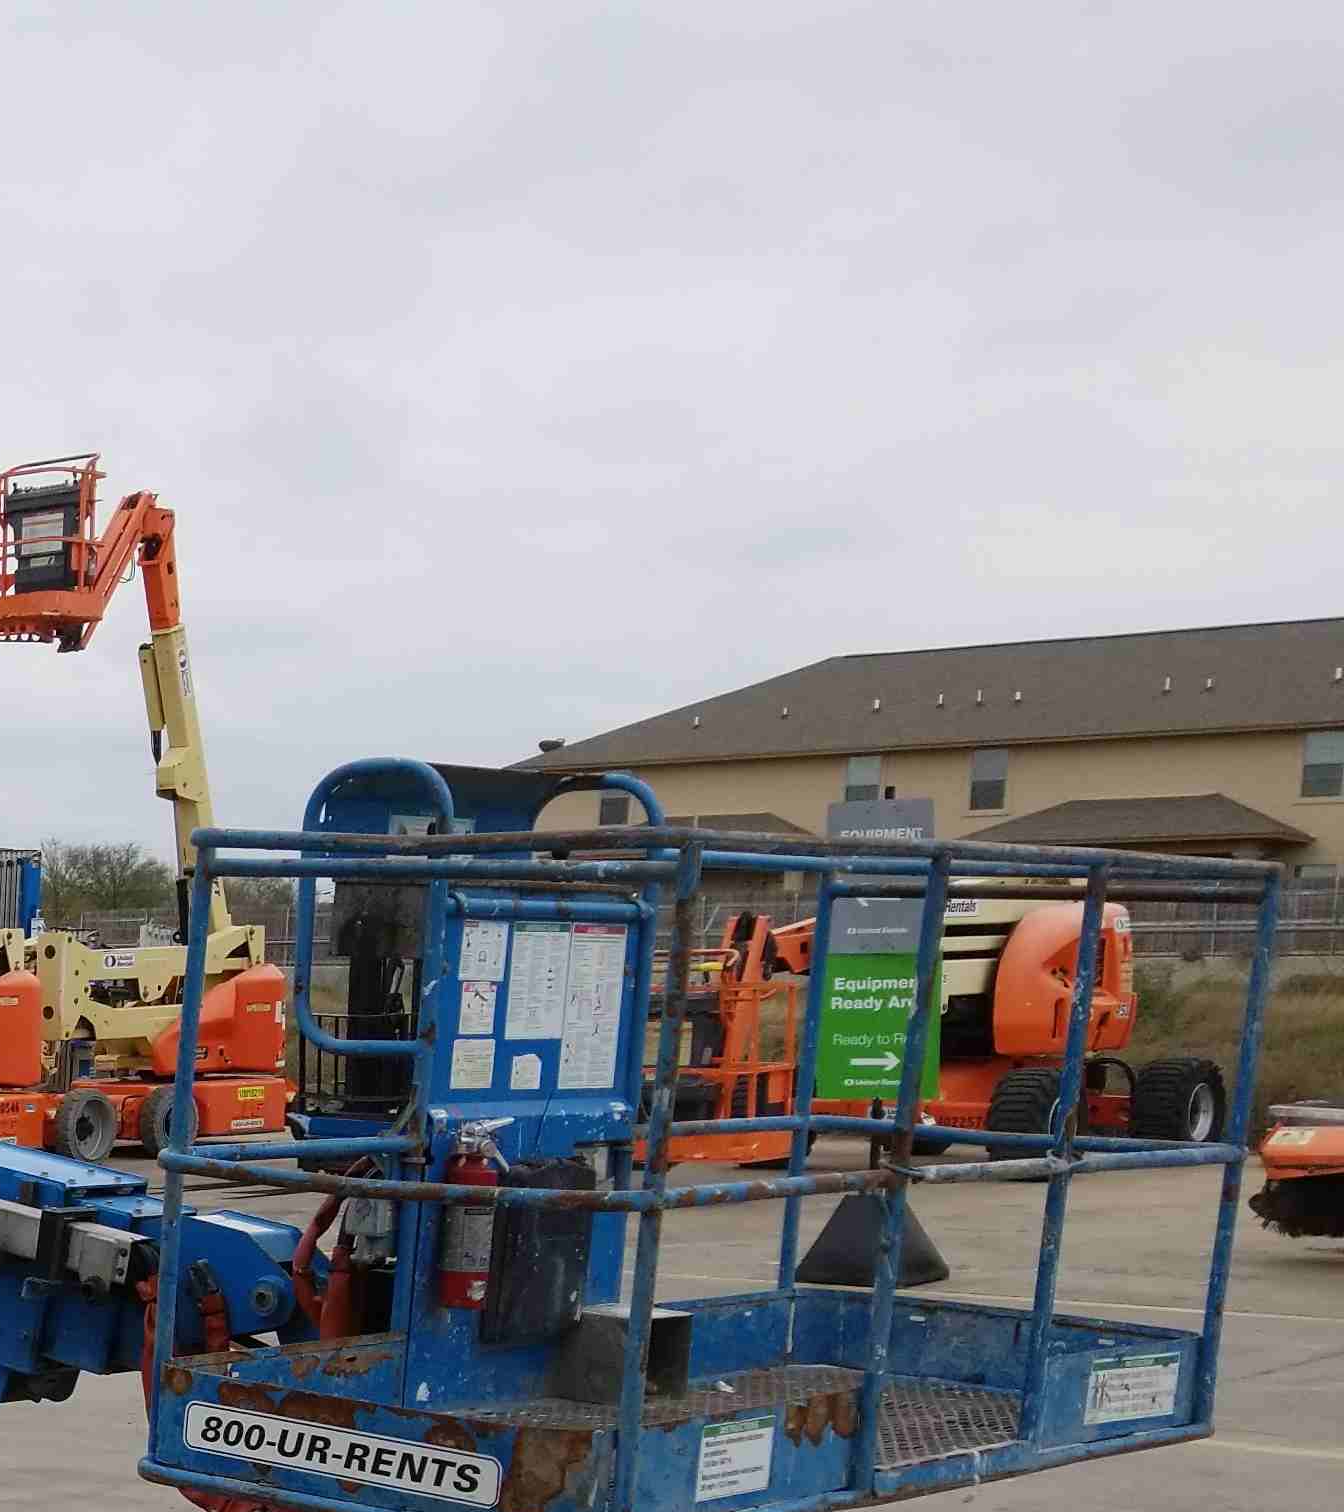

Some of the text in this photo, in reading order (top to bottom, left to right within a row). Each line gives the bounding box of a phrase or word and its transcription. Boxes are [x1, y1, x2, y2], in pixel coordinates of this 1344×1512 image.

[831, 996, 883, 1011] Ready
[832, 1033, 874, 1048] Ready
[877, 1034, 890, 1045] to
[200, 1416, 481, 1493] 800-UR-RENTS
